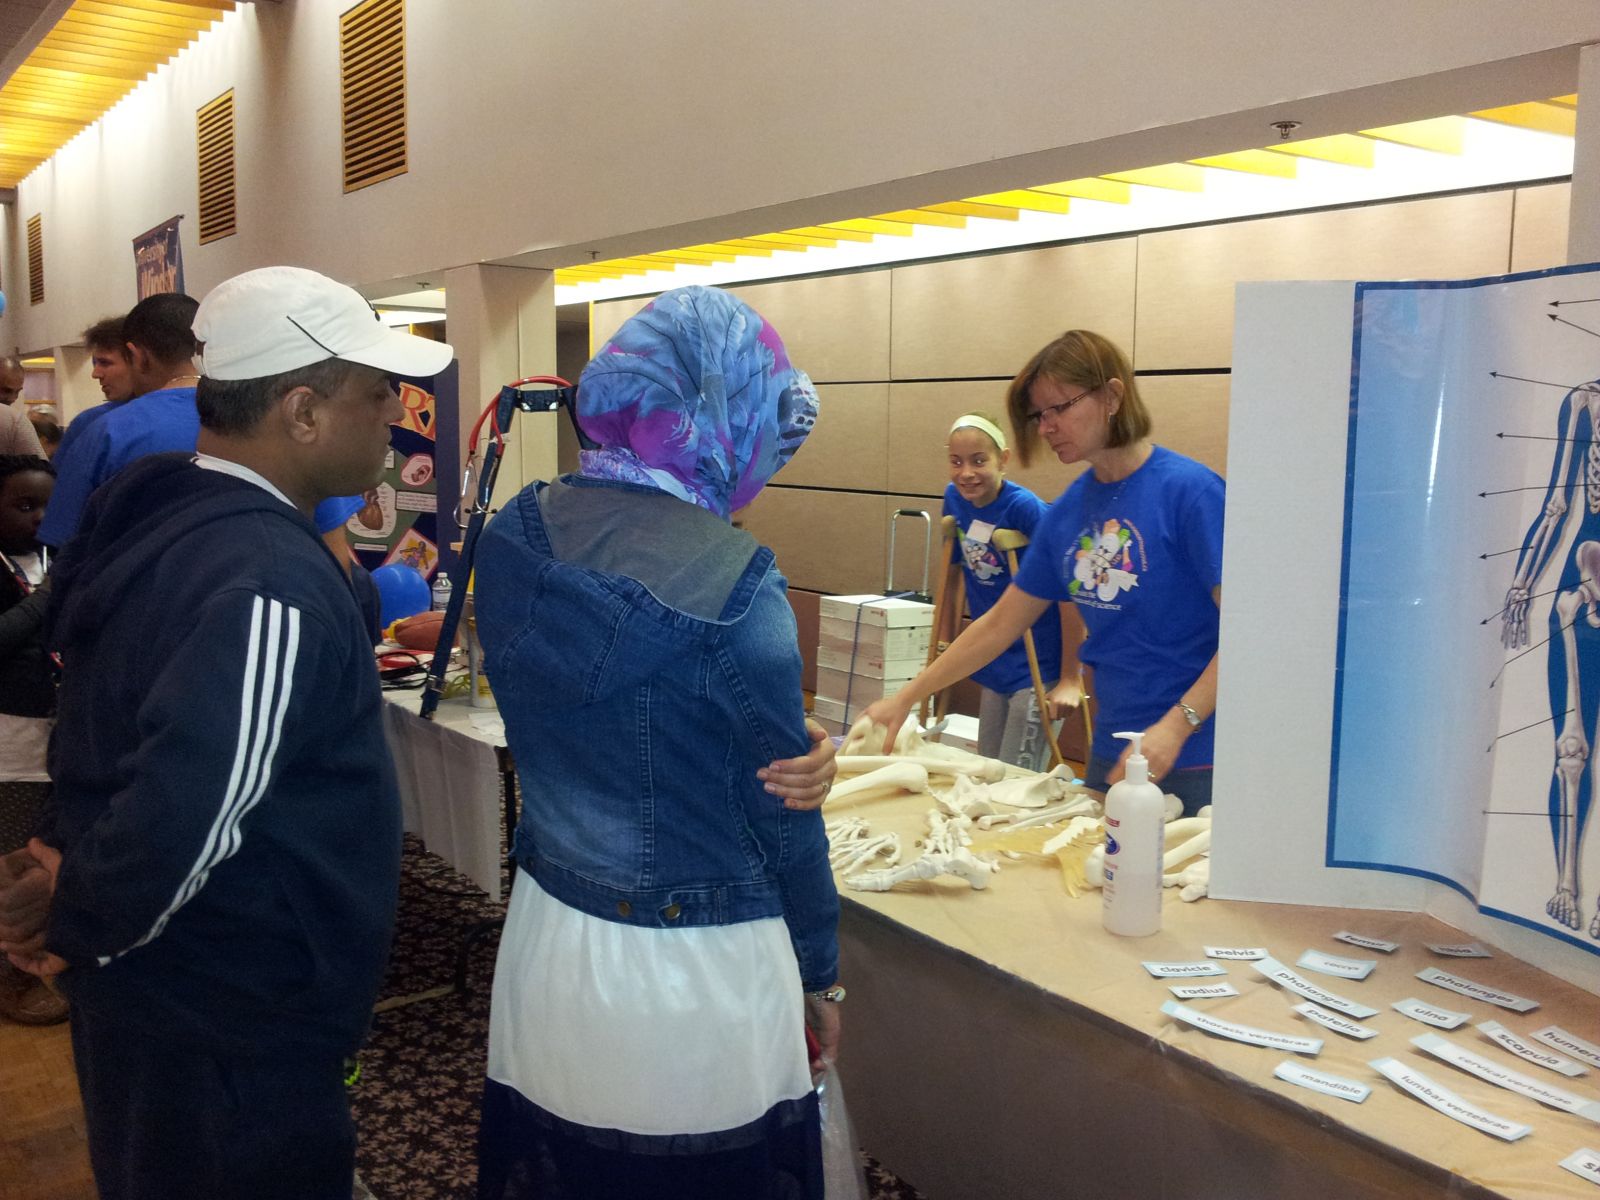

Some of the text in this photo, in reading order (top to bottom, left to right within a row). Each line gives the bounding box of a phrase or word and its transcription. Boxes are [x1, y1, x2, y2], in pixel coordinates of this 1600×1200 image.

[1214, 948, 1256, 958] pelvis
[1344, 935, 1387, 947] femur
[1160, 965, 1212, 973] clavicle
[1182, 986, 1227, 995] radius
[1277, 971, 1350, 1008] phalanges
[1434, 974, 1514, 1004] phalanges
[1306, 1008, 1362, 1033] patella
[1414, 1007, 1449, 1022] ulna
[1196, 1015, 1311, 1048] thoracic vertebrae
[1498, 1032, 1562, 1066] scapula
[1300, 1072, 1362, 1095] mandible
[1457, 1054, 1573, 1106] cervical vertebrae
[1401, 1074, 1510, 1131] lumbar vertebrae
